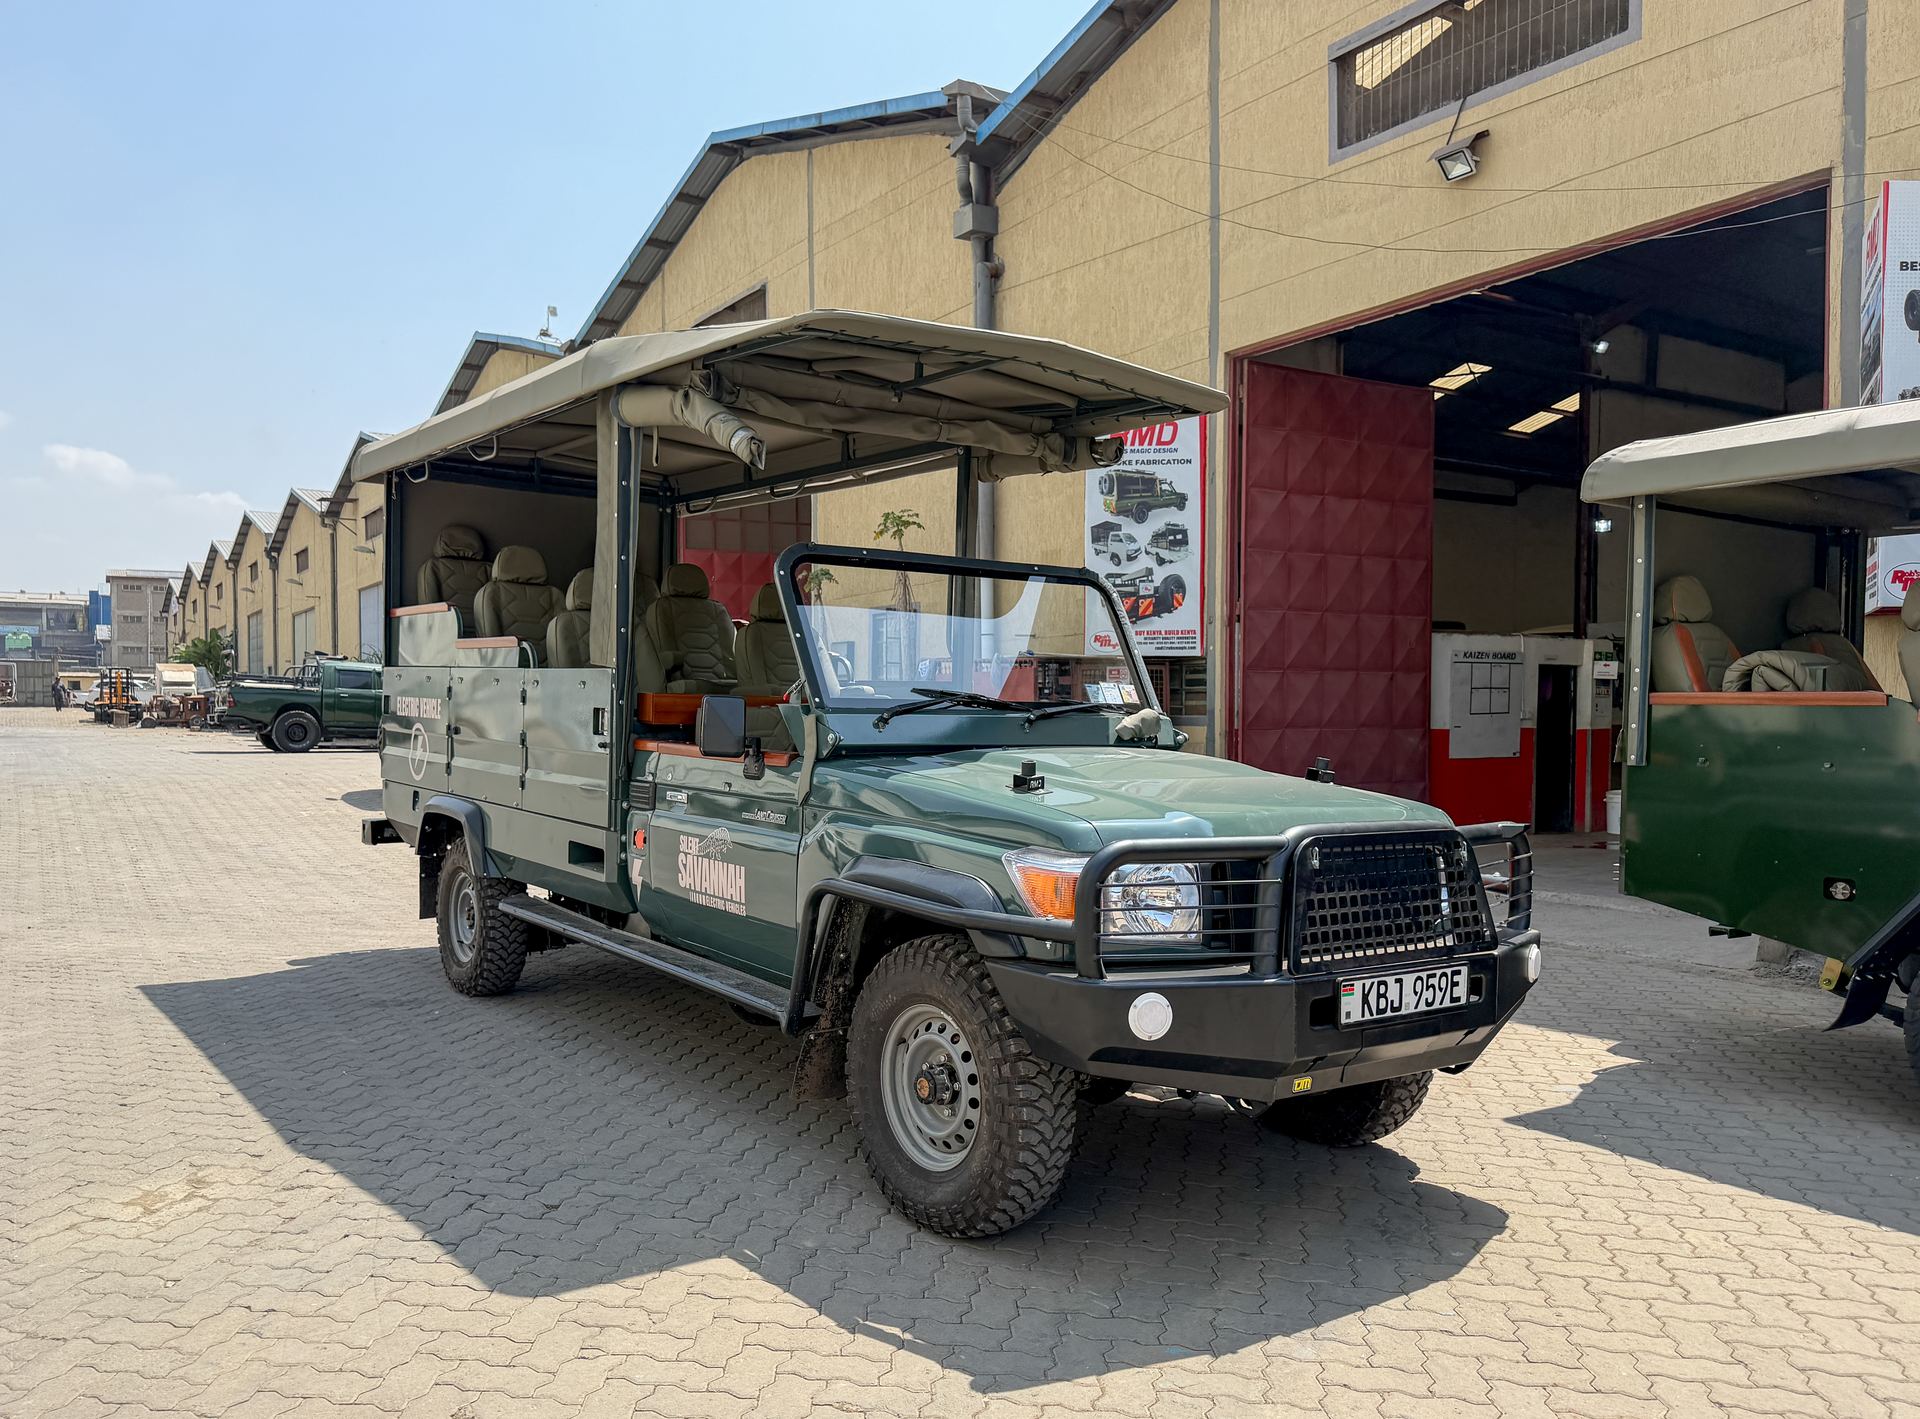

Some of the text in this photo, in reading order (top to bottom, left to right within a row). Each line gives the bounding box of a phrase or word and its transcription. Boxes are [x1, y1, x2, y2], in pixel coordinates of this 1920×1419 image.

[1900, 261, 1920, 271] BE
[1135, 458, 1192, 466] FABRICATION
[1463, 651, 1517, 660] KAIZEN BOARD
[397, 696, 441, 719] ELECTRIC VEHICLE
[678, 852, 746, 904] SAVANNAH
[1361, 969, 1462, 1019] KBJ 959E
